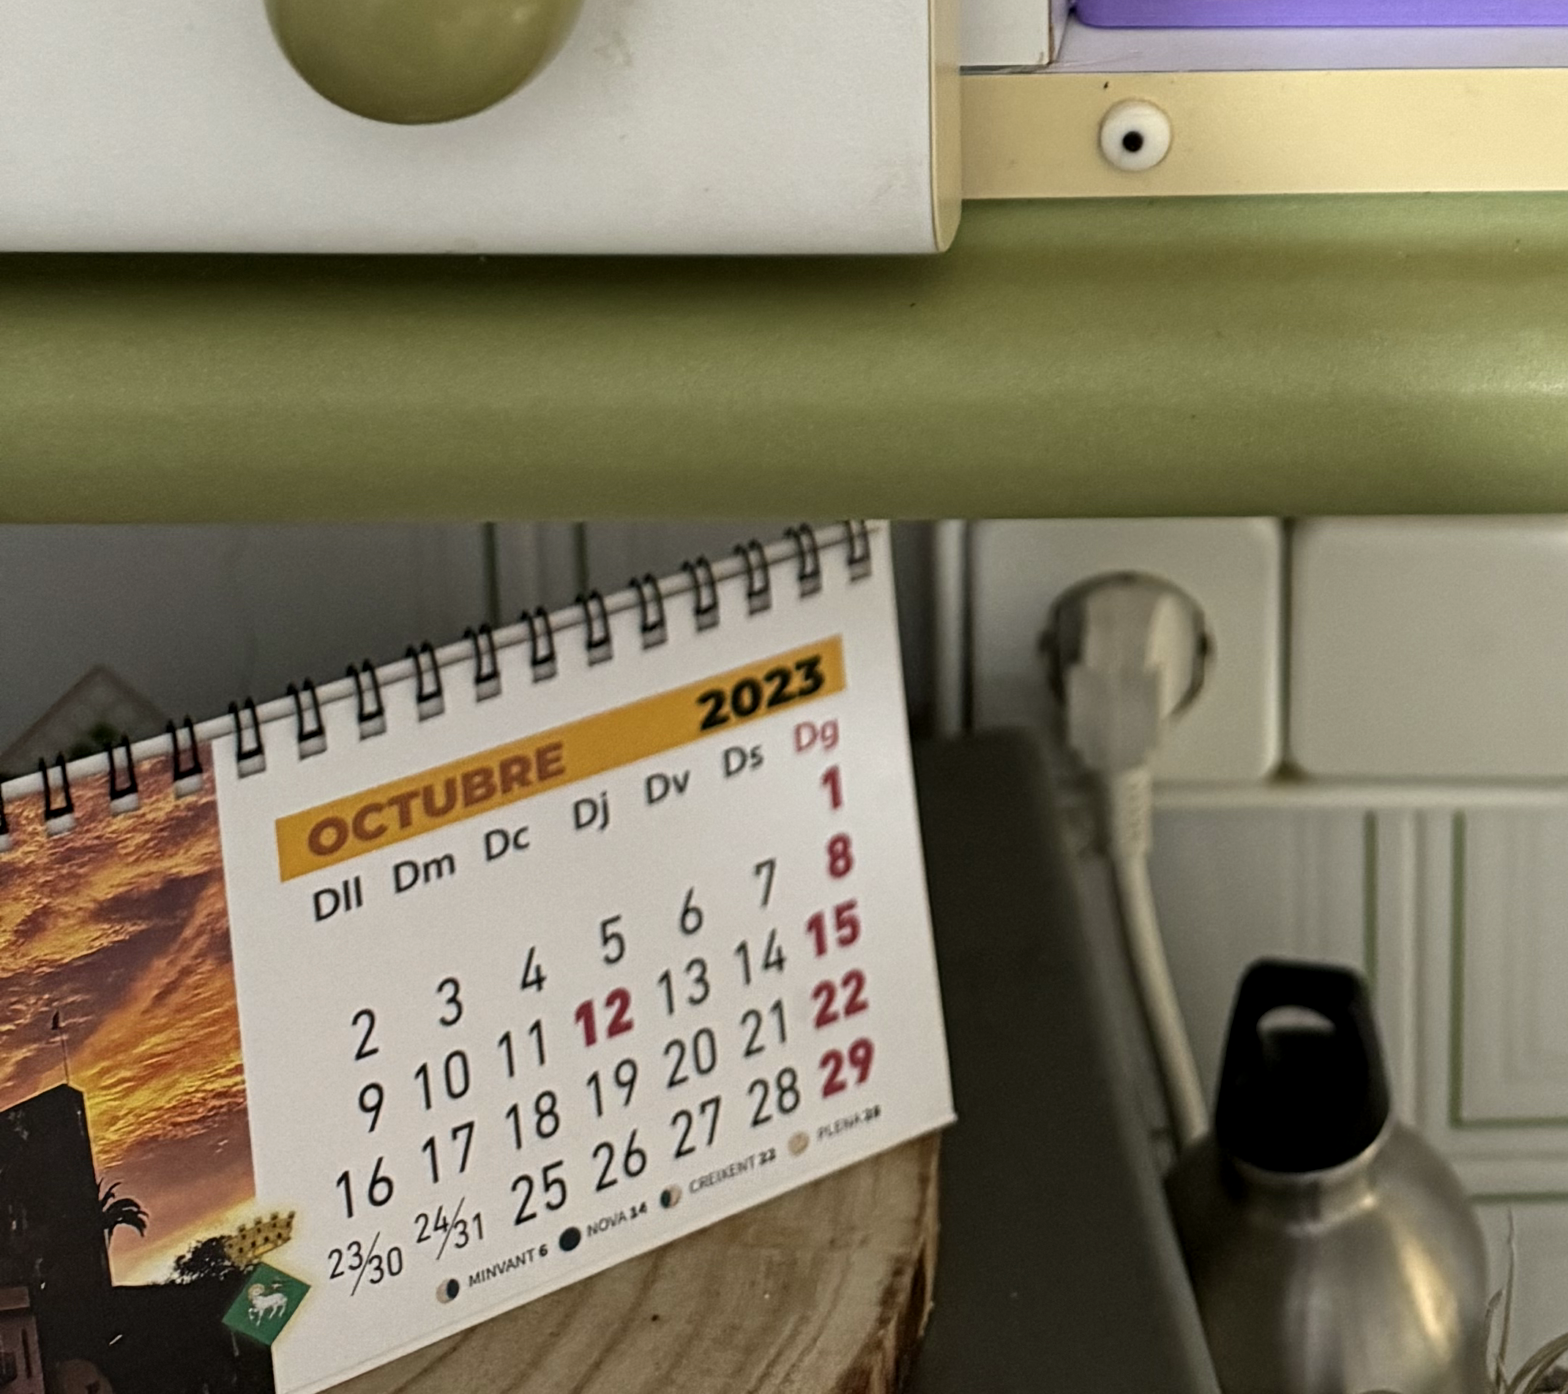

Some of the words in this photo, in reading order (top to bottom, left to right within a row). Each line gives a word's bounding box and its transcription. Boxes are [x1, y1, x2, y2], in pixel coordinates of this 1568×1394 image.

[695, 655, 826, 732] 2023
[306, 741, 566, 859] OCTUBRE
[393, 850, 455, 896] Dm
[484, 819, 531, 862] Dc
[573, 795, 611, 834] Dj
[645, 772, 691, 807] Dv
[722, 741, 764, 778] Ds
[794, 717, 841, 756] Dg
[820, 766, 843, 810] 1
[352, 1009, 380, 1060] 2
[436, 977, 464, 1028] 3
[520, 947, 546, 994] 4
[599, 916, 627, 965] 5
[678, 887, 705, 936] 6
[754, 858, 779, 908] 7
[827, 835, 853, 879] 8
[357, 1083, 385, 1134] 9
[413, 1050, 471, 1113] 10
[498, 1020, 550, 1080] 11
[576, 988, 634, 1048] 12
[658, 960, 711, 1017] 13
[734, 930, 787, 987] 14
[806, 903, 861, 957] 15
[327, 1231, 403, 1296] 23/30
[414, 1196, 485, 1260] 24/31
[510, 1160, 568, 1225] 25
[591, 1129, 648, 1192] 26
[671, 1098, 723, 1160] 27
[746, 1067, 801, 1128] 28
[820, 1038, 873, 1098] 29
[336, 1157, 395, 1218] 16
[422, 1124, 475, 1185] 17
[505, 1092, 562, 1152] 18
[586, 1058, 639, 1119] 19
[663, 1028, 717, 1089] 20
[740, 1000, 789, 1059] 21
[811, 970, 869, 1029] 22
[468, 1247, 535, 1287] MINVANT
[538, 1243, 549, 1257] 6
[586, 1212, 627, 1237] NOVA
